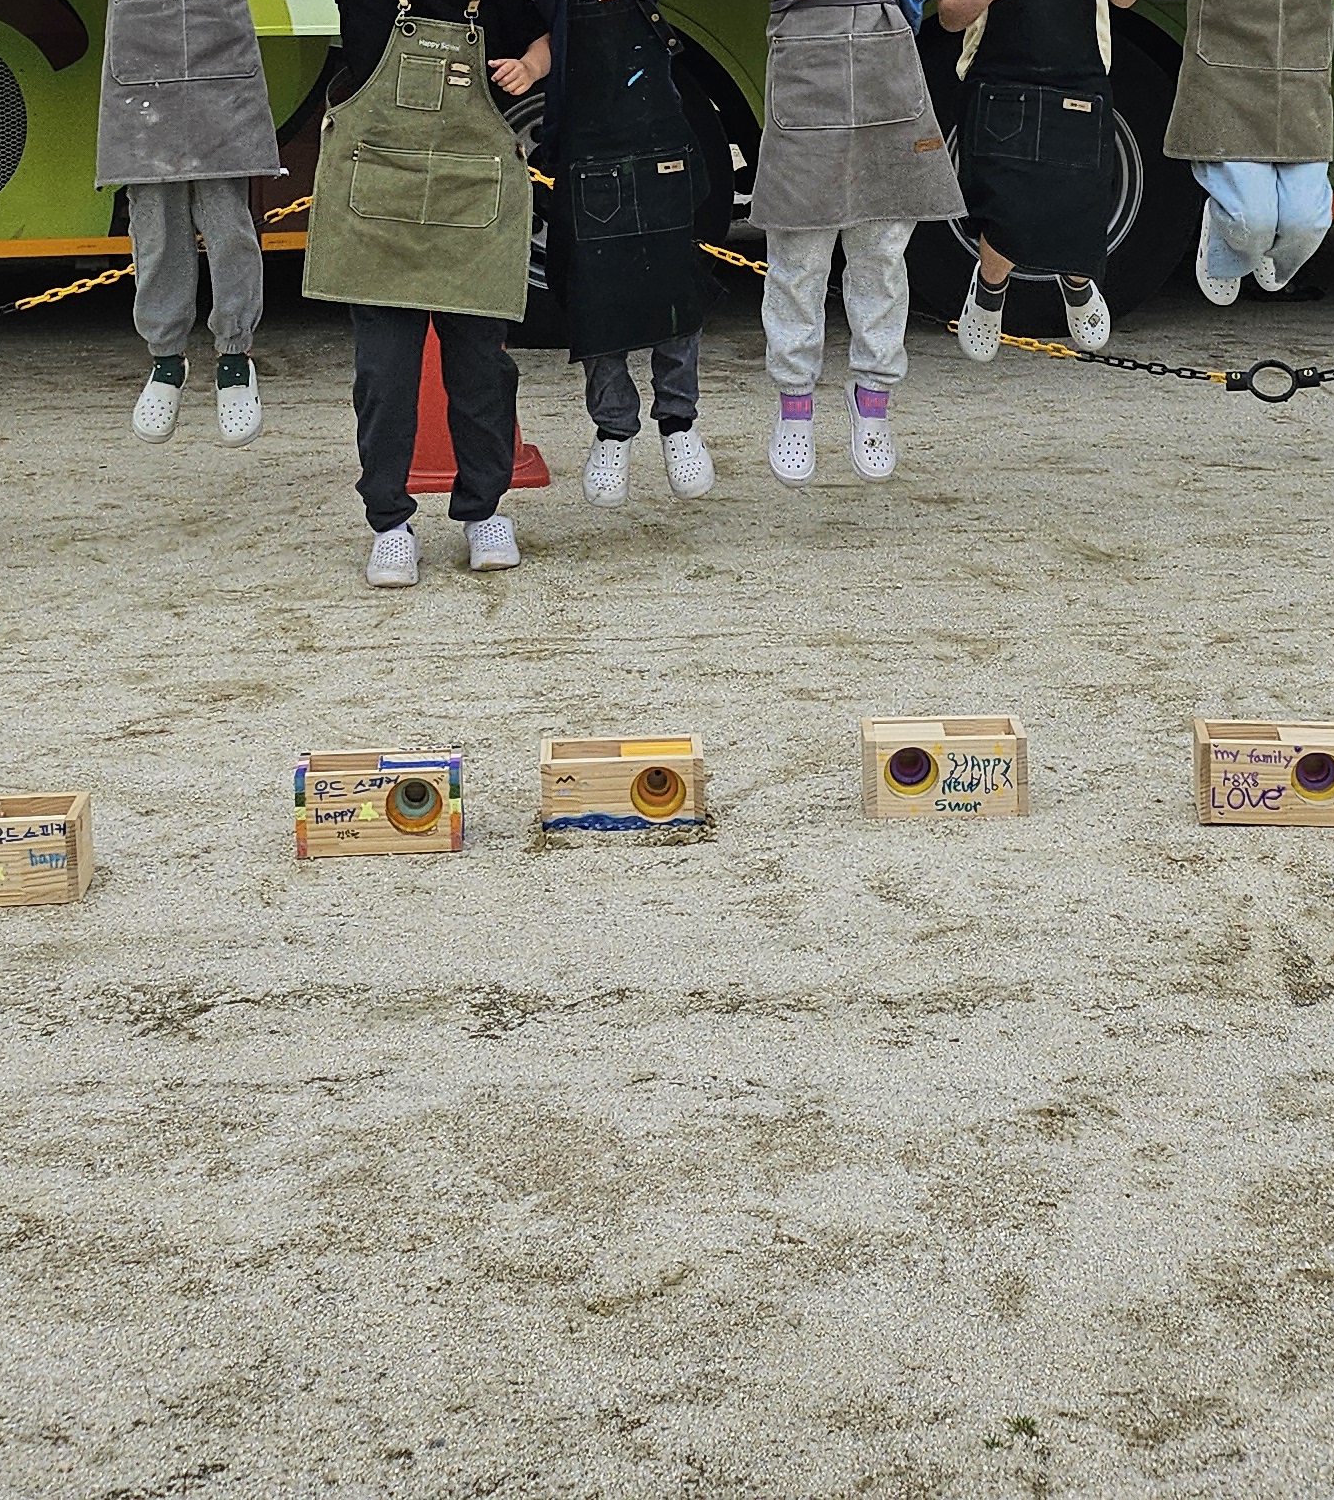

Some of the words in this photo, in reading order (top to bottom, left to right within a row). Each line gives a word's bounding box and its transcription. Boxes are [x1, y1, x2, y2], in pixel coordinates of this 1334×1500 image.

[1214, 749, 1240, 762] my
[1246, 748, 1294, 769] family
[313, 779, 348, 801] 우드
[315, 807, 357, 825] happy
